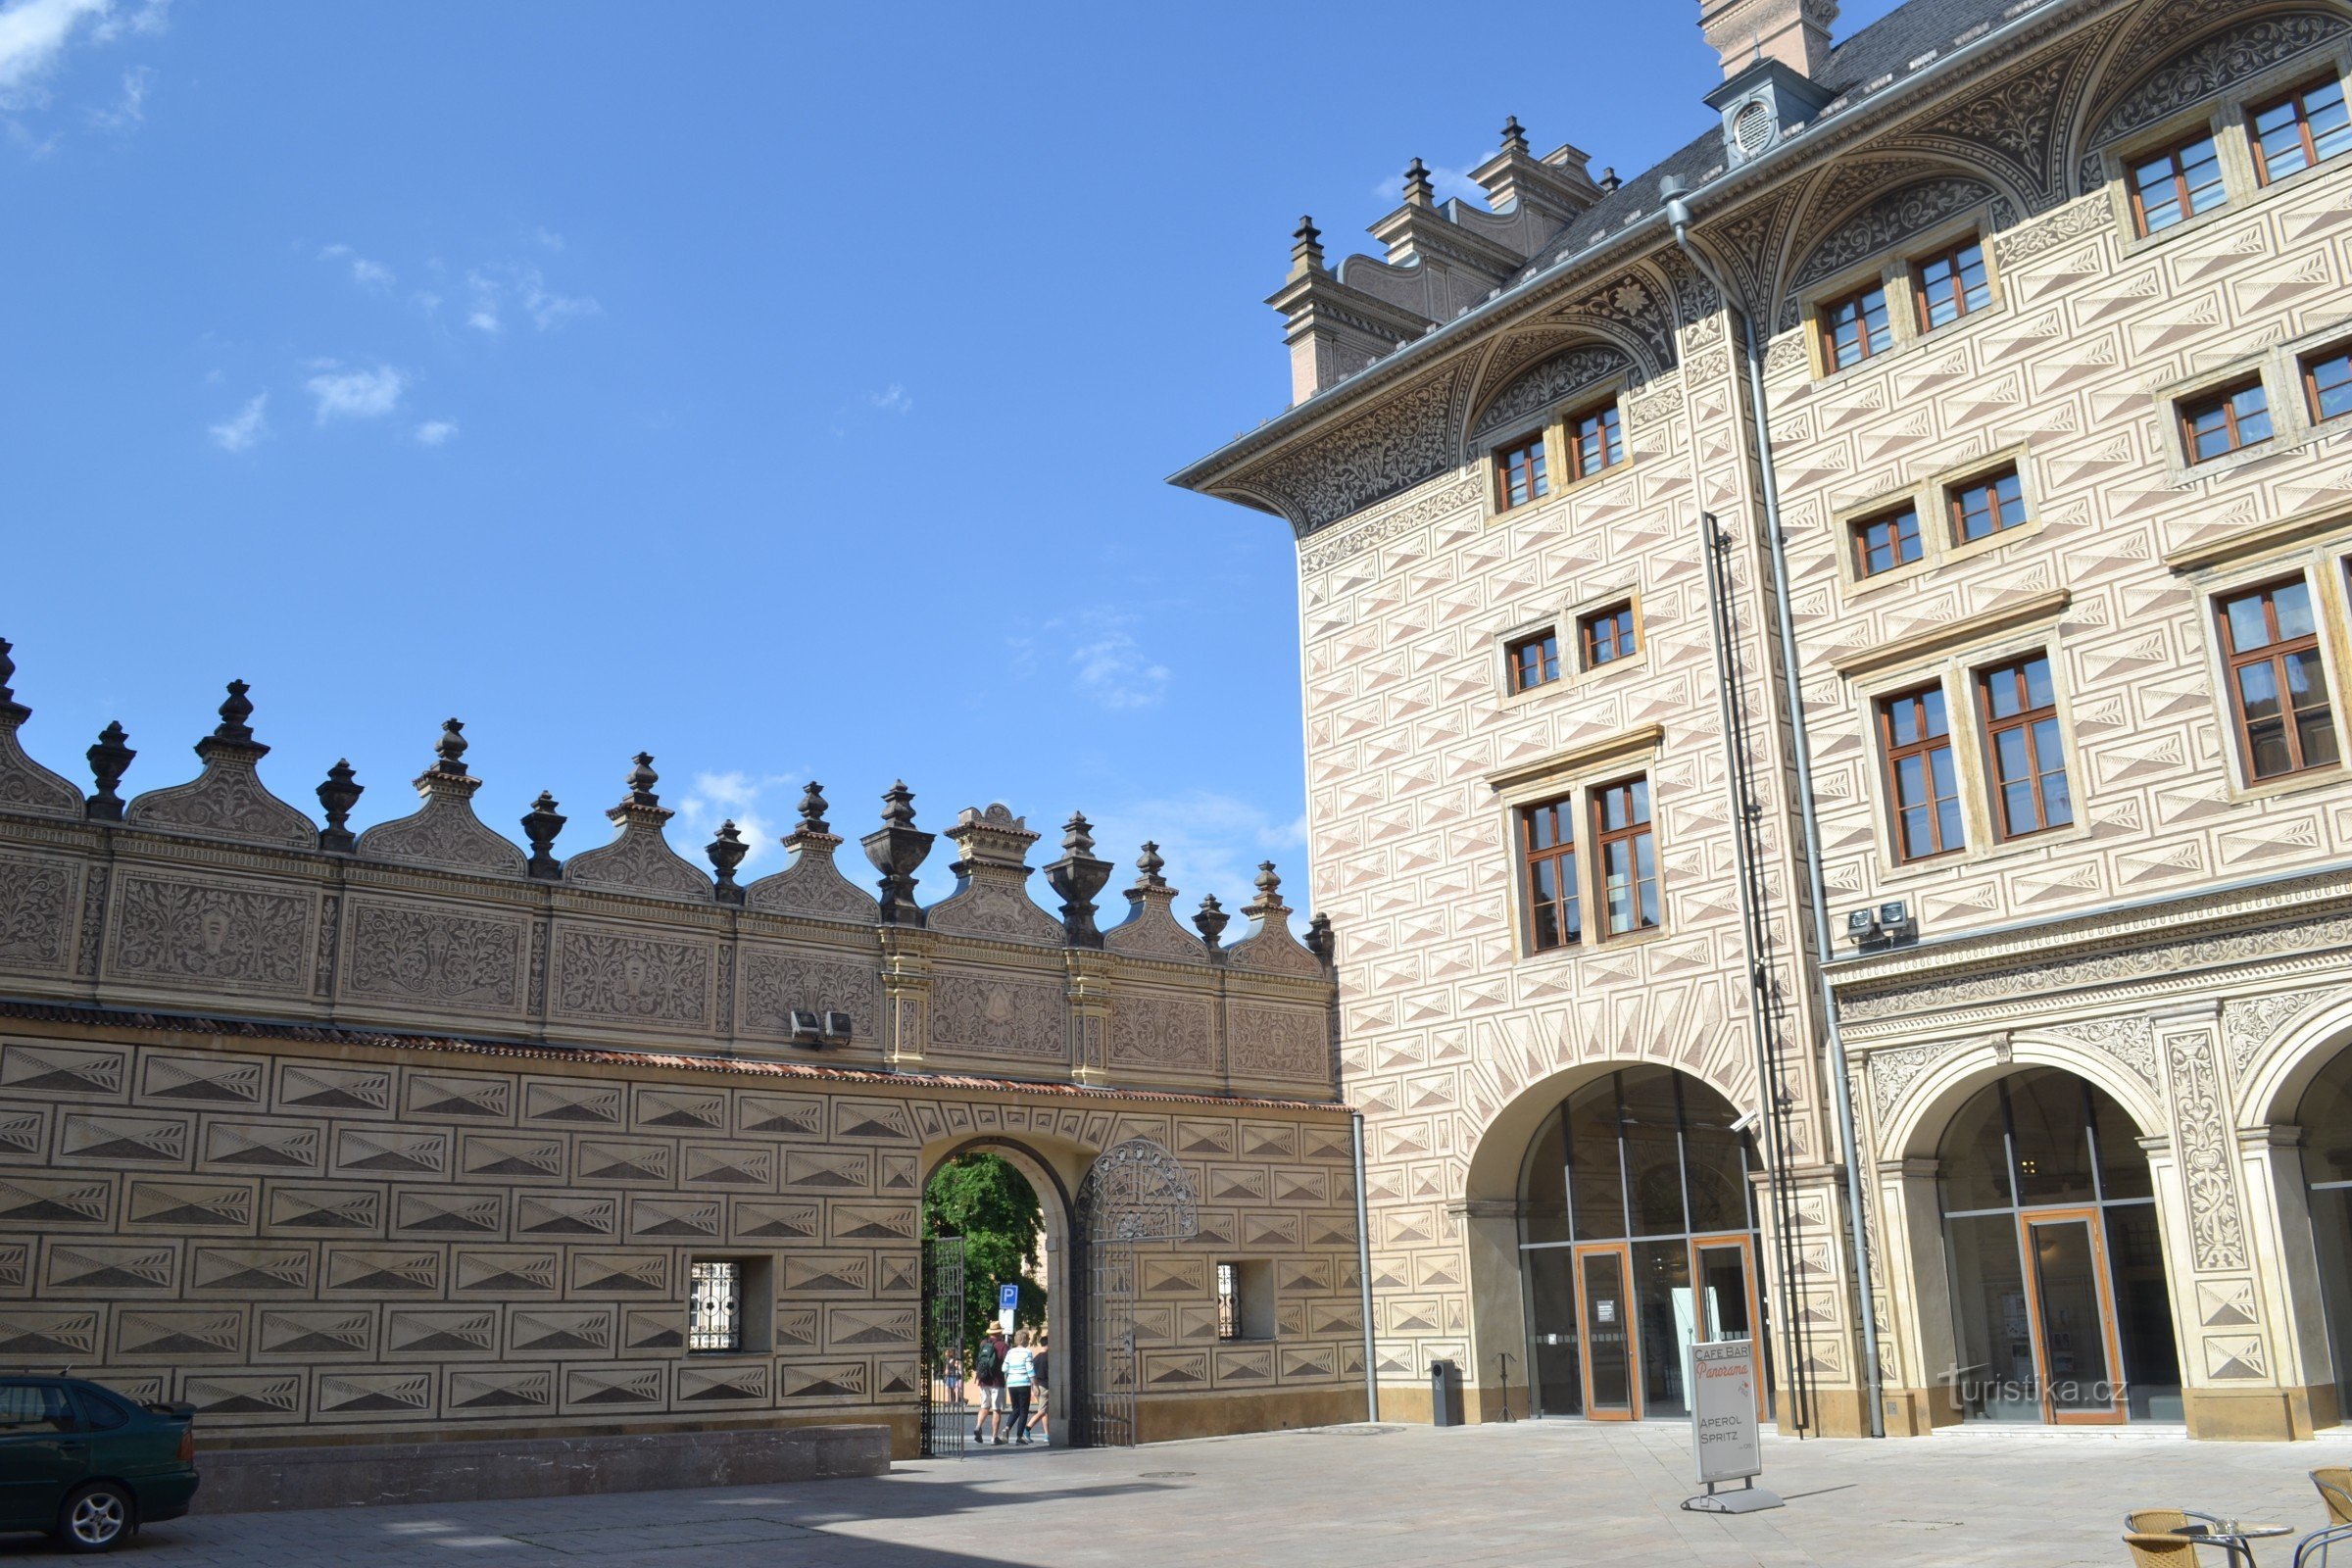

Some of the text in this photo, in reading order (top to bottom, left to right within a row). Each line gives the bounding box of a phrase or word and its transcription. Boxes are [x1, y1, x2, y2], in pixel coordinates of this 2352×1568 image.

[1004, 1289, 1014, 1302] P
[1694, 1347, 1748, 1360] CAFE BAR
[1696, 1361, 1748, 1379] Panorama
[1700, 1416, 1741, 1428] APEROL
[1700, 1432, 1738, 1445] SPRITZ
